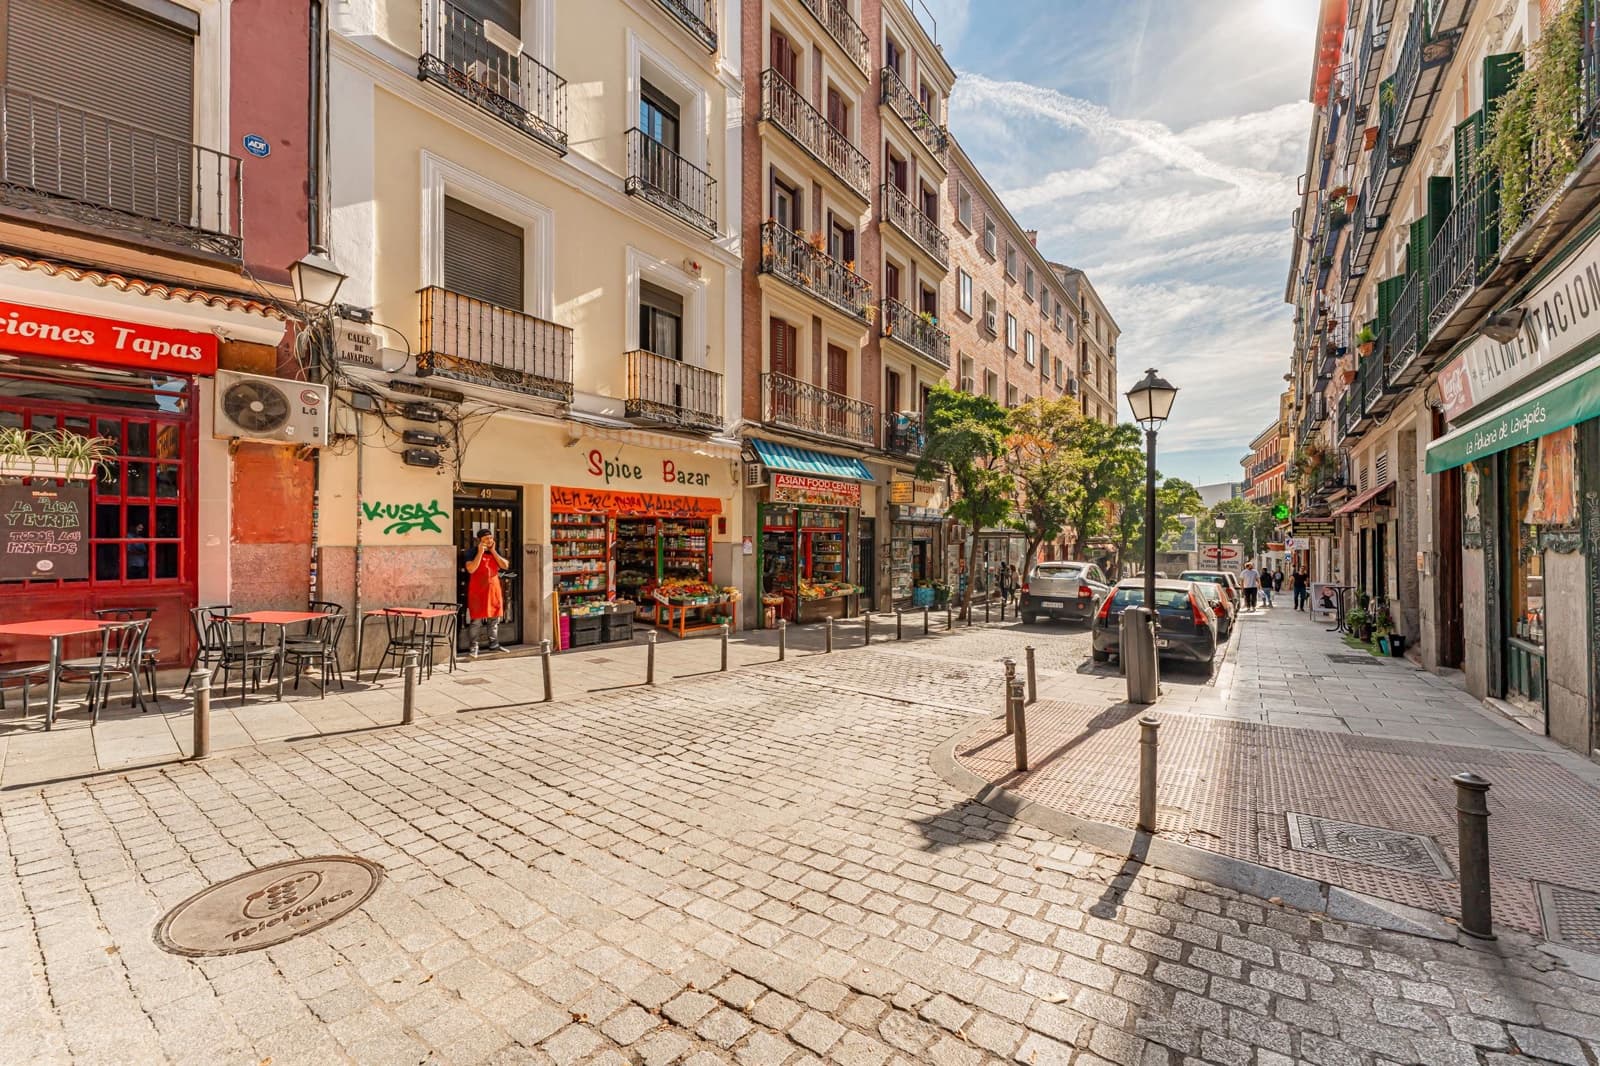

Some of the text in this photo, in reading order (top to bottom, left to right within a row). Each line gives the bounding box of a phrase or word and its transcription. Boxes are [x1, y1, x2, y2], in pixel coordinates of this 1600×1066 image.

[1485, 261, 1600, 381] ALIMENTACION
[112, 327, 202, 360] Tapas
[347, 332, 371, 346] CALLE
[341, 350, 374, 365] LAVAPIES
[302, 407, 318, 416] LG
[1498, 420, 1509, 440] de
[588, 450, 711, 486] Spice Bazar
[779, 475, 806, 486] ASIAN
[807, 478, 831, 488] FOOD
[831, 482, 860, 491] CENTER
[480, 489, 492, 498] 49
[5, 513, 80, 528] Y EUROPA
